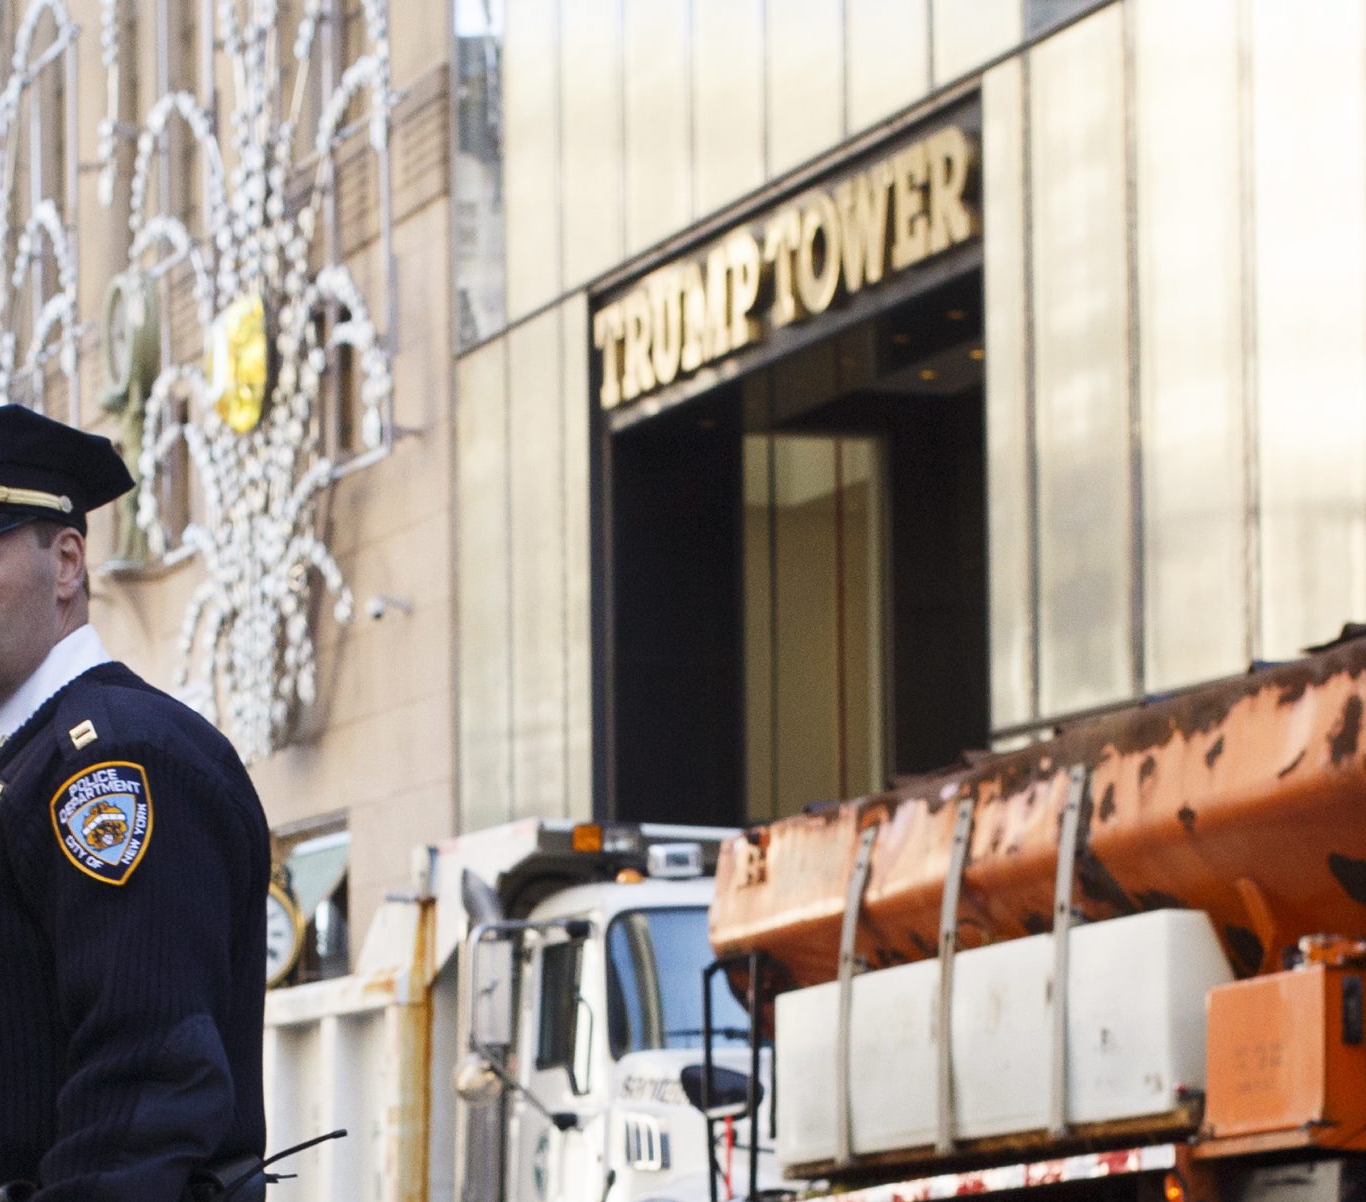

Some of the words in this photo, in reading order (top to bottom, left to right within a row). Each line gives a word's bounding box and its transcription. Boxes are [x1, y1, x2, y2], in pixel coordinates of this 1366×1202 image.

[594, 226, 761, 410] TRUMP
[763, 126, 971, 328] TOWER
[59, 780, 141, 824] DEPARTMENT
[68, 768, 118, 797] POLICE
[65, 835, 88, 859] CITY
[85, 856, 104, 869] OF
[121, 838, 141, 865] NEW
[134, 803, 147, 835] YORK
